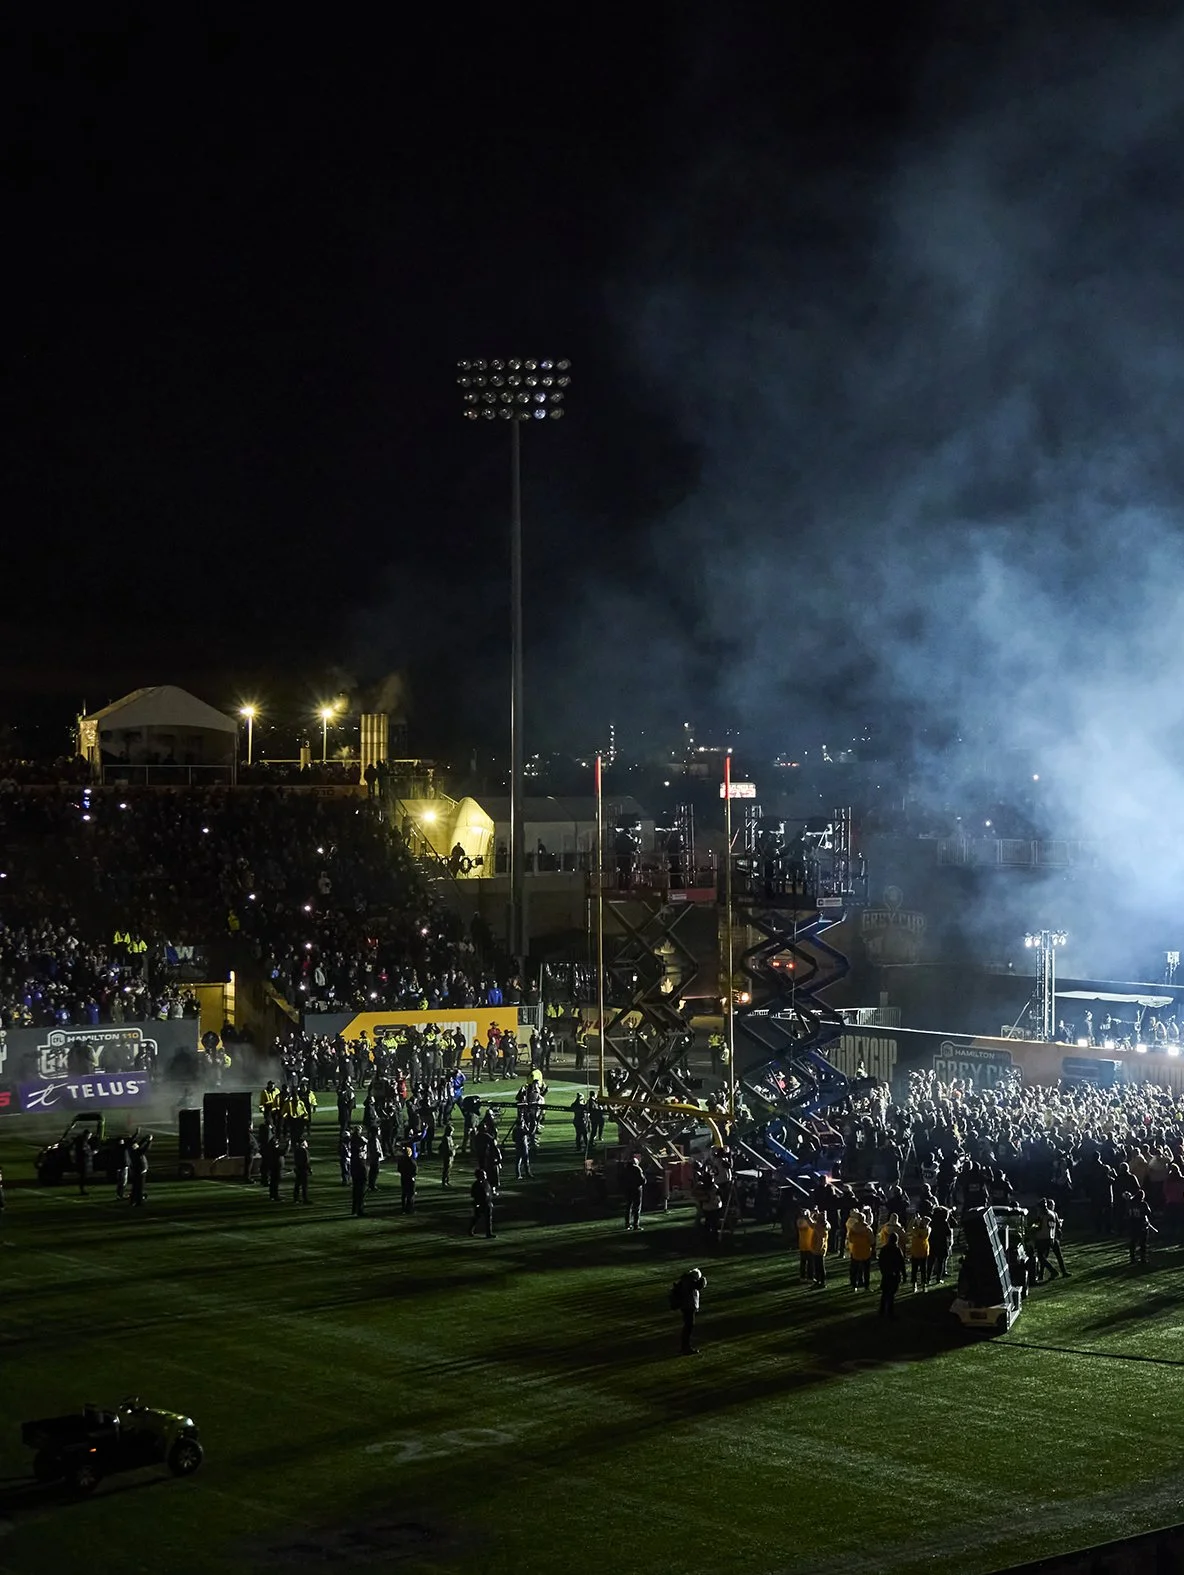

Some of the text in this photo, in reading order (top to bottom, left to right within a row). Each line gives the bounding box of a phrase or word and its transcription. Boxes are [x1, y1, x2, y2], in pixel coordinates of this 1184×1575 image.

[67, 1034, 119, 1043] HAMILTON
[955, 1049, 994, 1059] HAMILTON
[67, 1080, 140, 1099] TELUS
